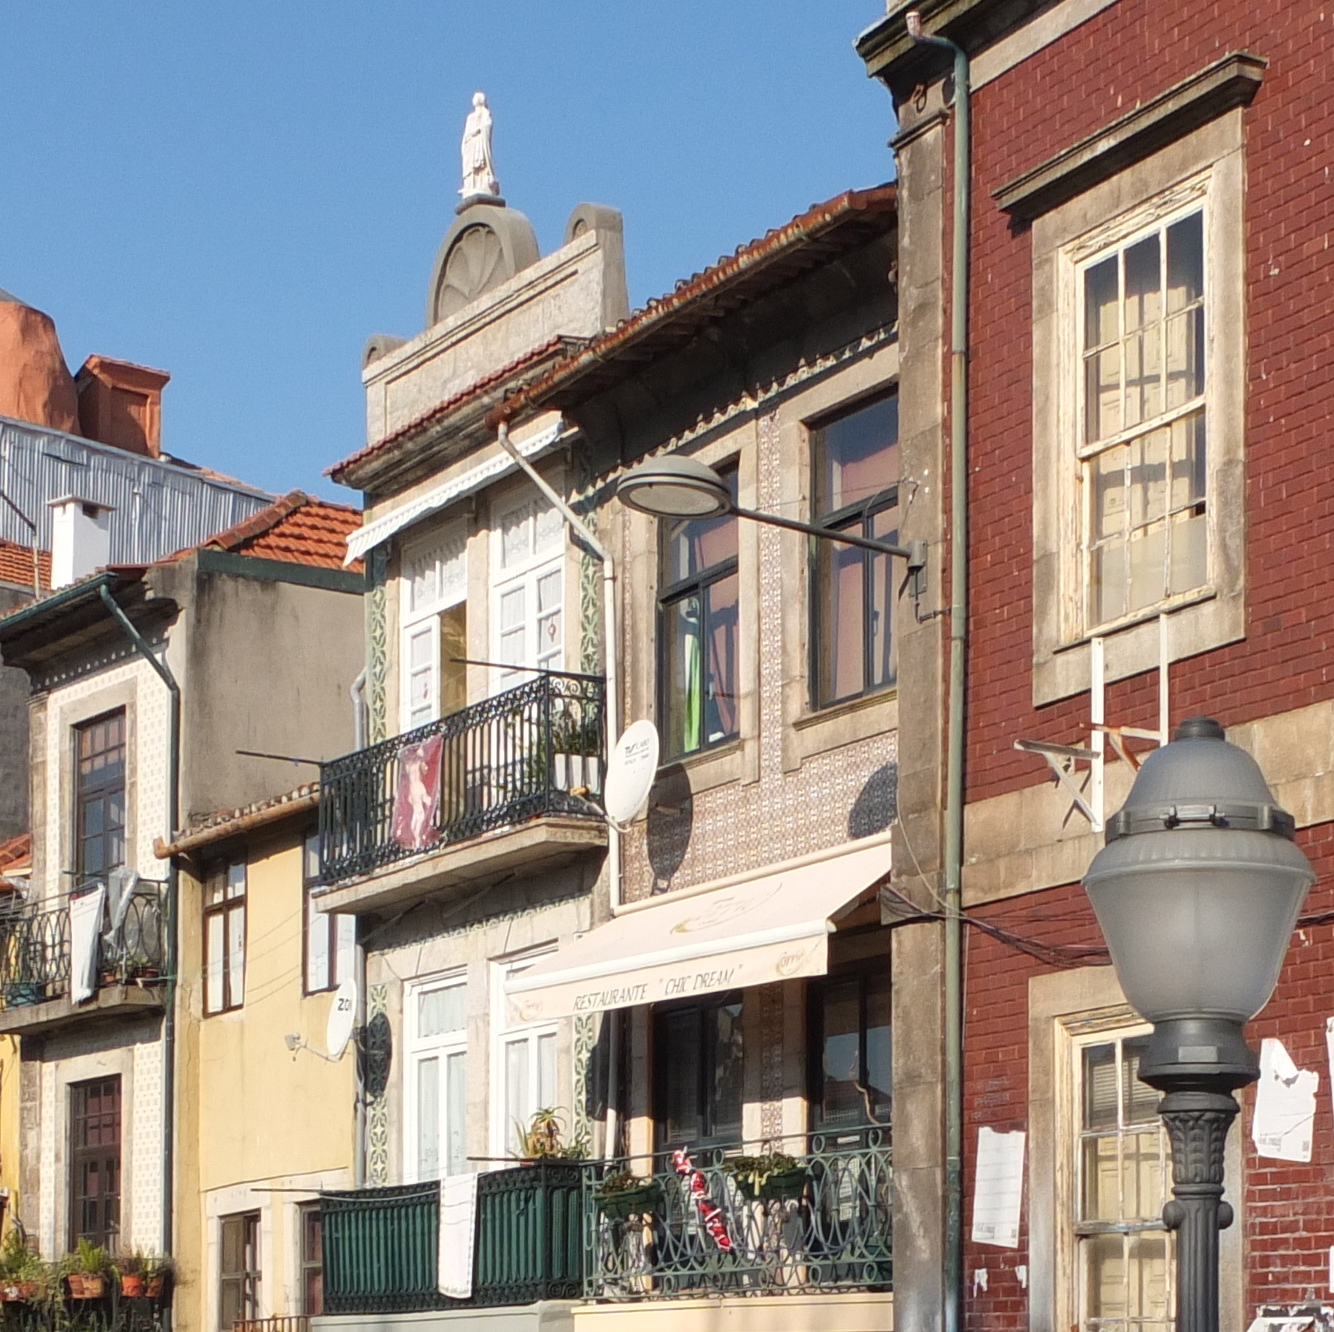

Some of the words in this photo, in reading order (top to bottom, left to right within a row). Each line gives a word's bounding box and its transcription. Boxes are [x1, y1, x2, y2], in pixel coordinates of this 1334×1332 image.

[573, 983, 649, 1011] RESTAURANTE
[664, 974, 697, 996] CHIC
[692, 969, 736, 991] DREAM
